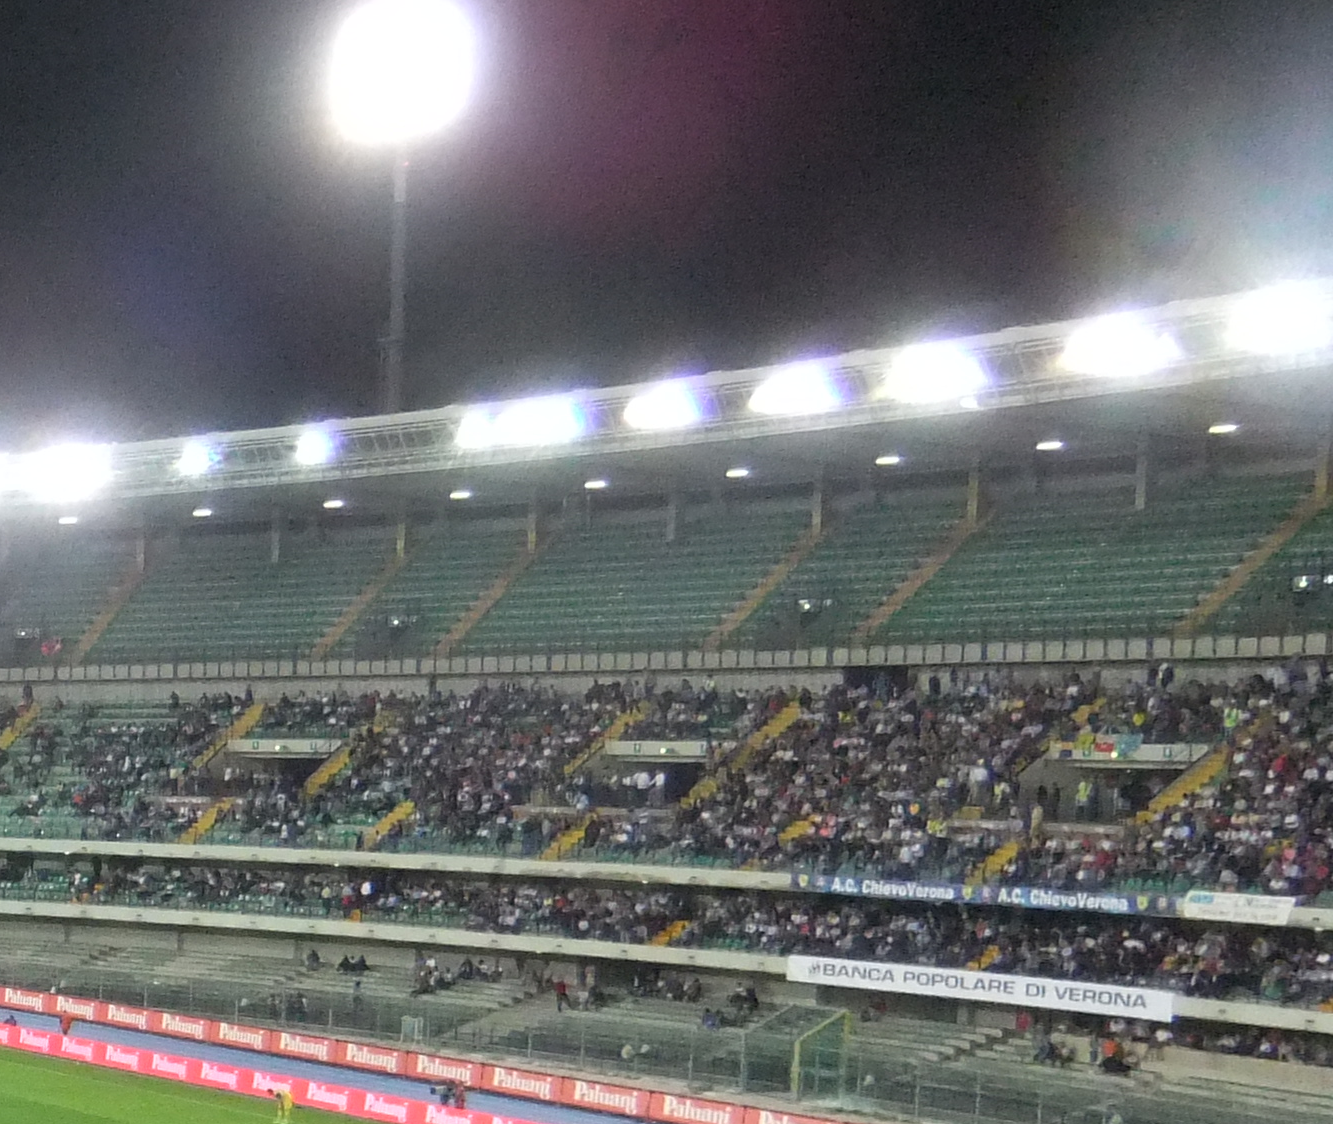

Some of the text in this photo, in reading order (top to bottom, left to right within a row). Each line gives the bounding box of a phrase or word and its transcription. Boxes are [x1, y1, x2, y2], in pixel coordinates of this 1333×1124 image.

[862, 880, 954, 900] ChievoVerona
[1029, 890, 1129, 912] ChievoVerona
[822, 963, 1148, 1009] BANCA POPOLARE DI VERONA
